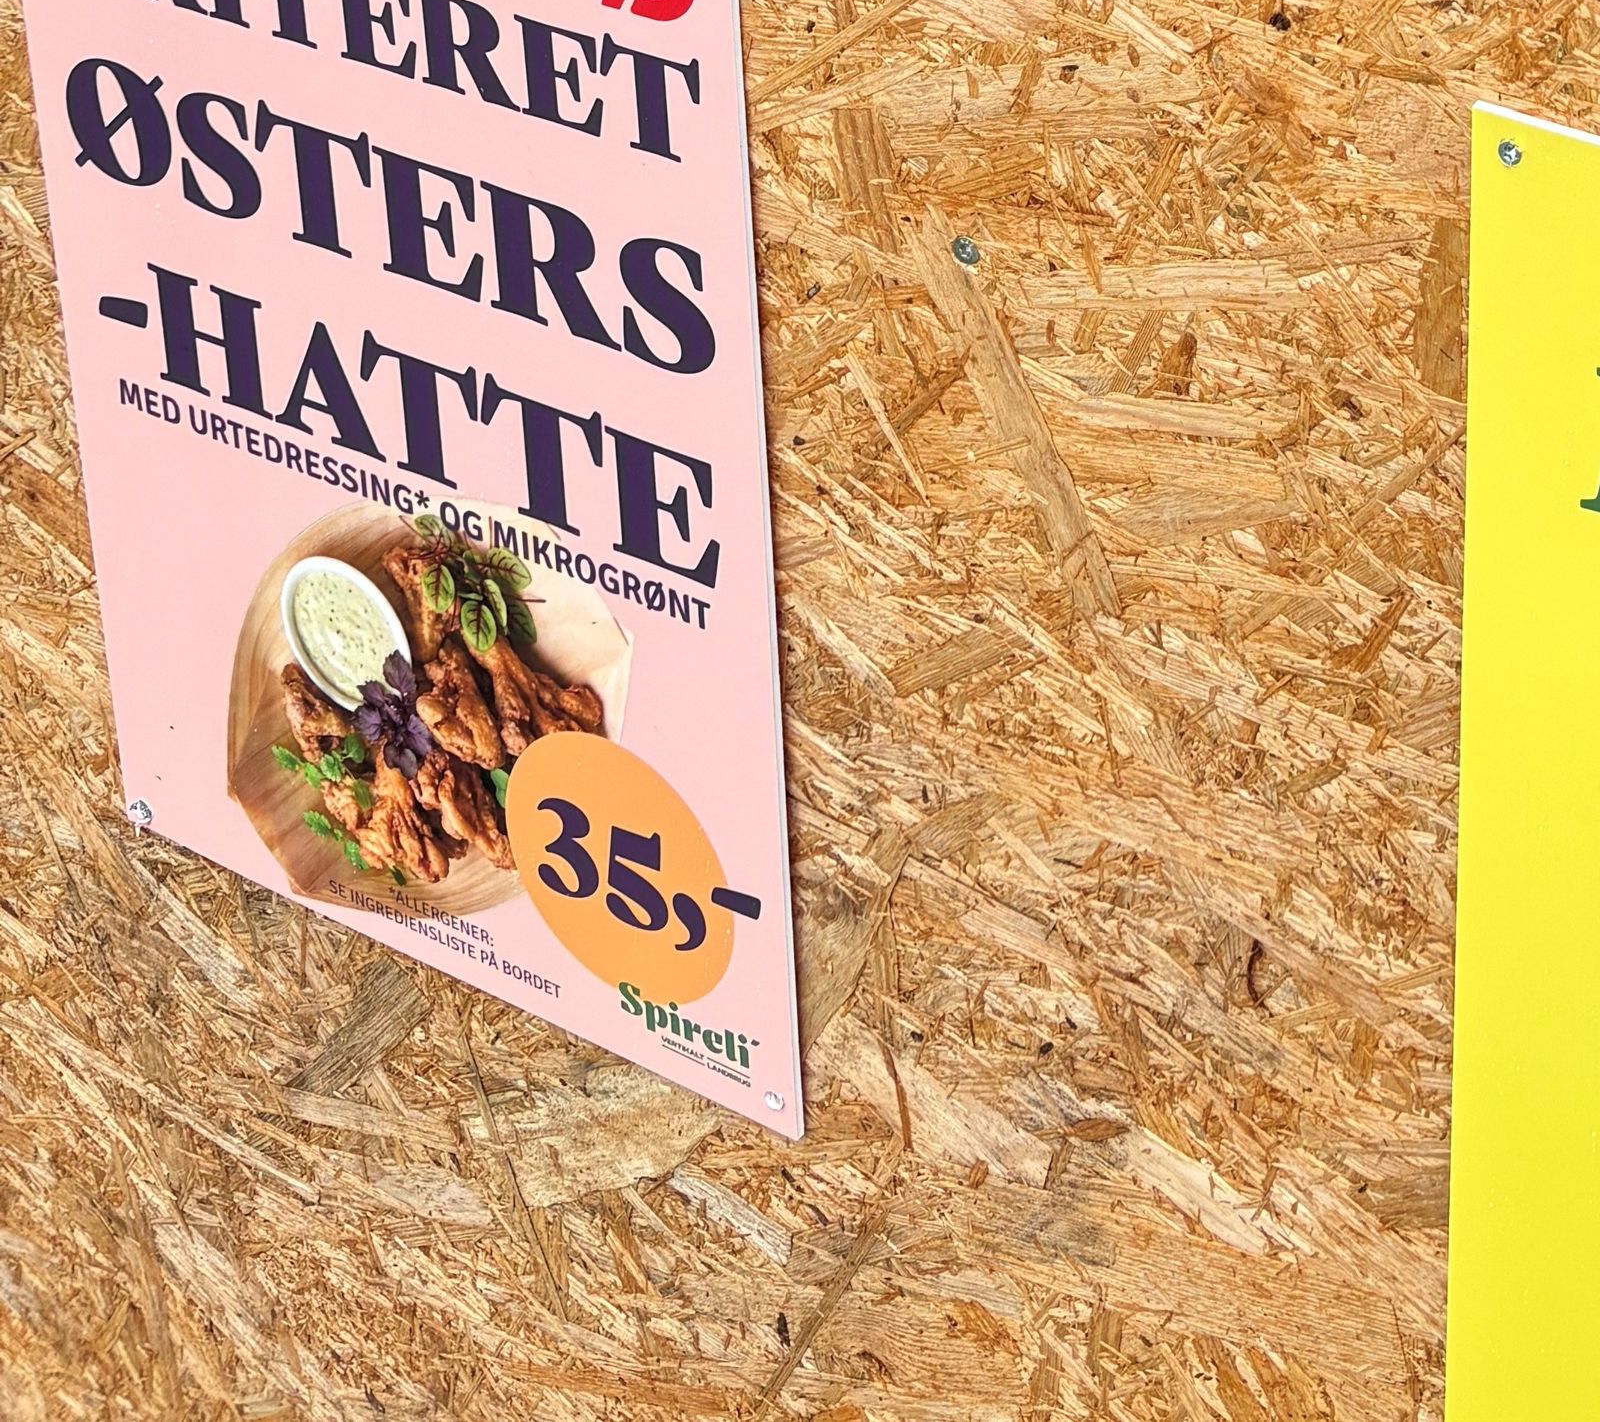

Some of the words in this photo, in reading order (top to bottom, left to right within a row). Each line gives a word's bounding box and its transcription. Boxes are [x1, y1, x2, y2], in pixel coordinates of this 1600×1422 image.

[66, 58, 717, 375] ØSTERS
[98, 262, 721, 590] -HATTE
[119, 378, 181, 425] MED
[440, 501, 484, 542] OG
[492, 520, 711, 630] MIKROGRØNT
[329, 879, 347, 900] SE
[350, 891, 477, 959] INGREDIENSLISTE
[480, 949, 499, 970] PÅ
[502, 960, 561, 998] BORDET
[537, 797, 761, 952] 35,-
